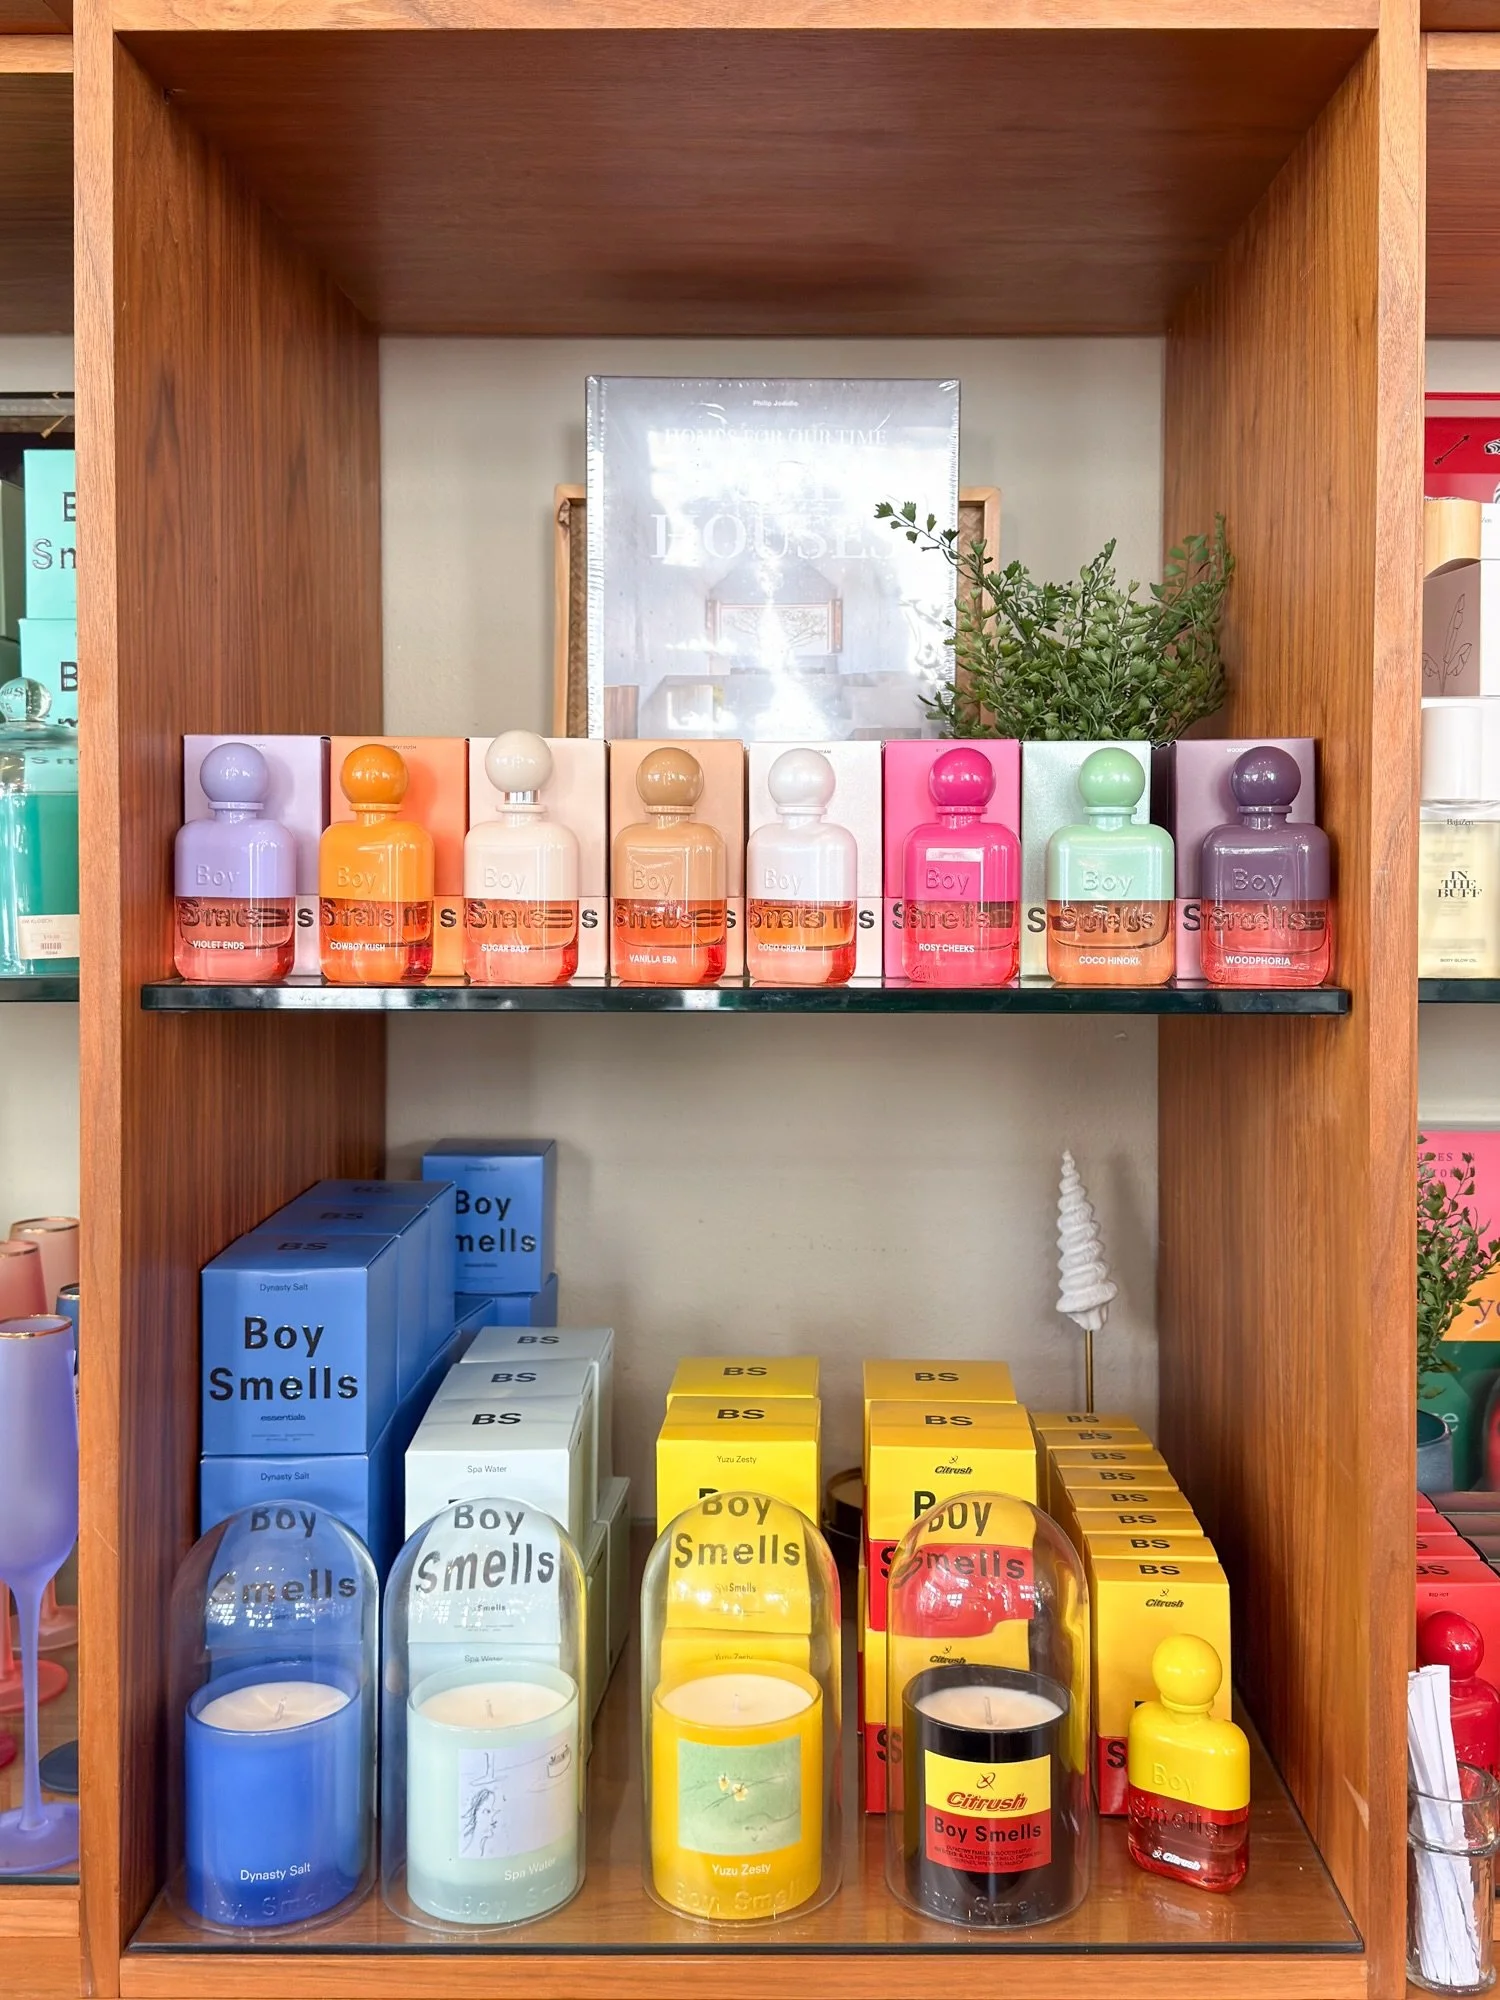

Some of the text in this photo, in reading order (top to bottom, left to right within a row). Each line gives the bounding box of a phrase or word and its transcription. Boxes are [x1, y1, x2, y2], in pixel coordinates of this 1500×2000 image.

[838, 428, 888, 446] TIME
[651, 513, 896, 560] HOUSES
[196, 864, 241, 891] Boy
[336, 867, 377, 893] Boy
[484, 867, 528, 895] Boy
[764, 867, 804, 895] Boy
[925, 866, 971, 895] Boy
[1451, 871, 1468, 880] IN
[632, 868, 675, 897] Boy
[1081, 869, 1136, 898] Boy
[1231, 868, 1284, 897] Boy
[1441, 880, 1476, 889] THE
[1437, 889, 1483, 898] BUFF
[192, 940, 245, 951] VIOLET ENDS
[330, 941, 386, 952] COWBOY KUSH
[480, 943, 531, 953] SUGAR BABY
[780, 944, 807, 953] CREAM
[918, 943, 975, 953] ROSY CHEEKS
[628, 954, 678, 965] VANILLA ERA
[1079, 956, 1140, 966] COCO HINOKI
[1225, 955, 1292, 966] WOODPHORIA
[455, 1189, 512, 1221] Boy
[455, 1227, 537, 1253] mells
[276, 1242, 330, 1251] BS
[259, 1283, 309, 1292] Dynasty Salt
[244, 1315, 325, 1358] Boy
[517, 1335, 561, 1345] BS
[722, 1366, 768, 1376] BS
[490, 1372, 538, 1383] BS
[914, 1372, 960, 1382] BS
[209, 1365, 359, 1401] Smells
[472, 1412, 523, 1425] BS
[717, 1409, 766, 1420] BS
[1066, 1415, 1100, 1424] BS
[924, 1415, 974, 1426] BS
[1078, 1432, 1113, 1440] BS
[717, 1455, 757, 1465] Yuzu Zesty
[1091, 1452, 1127, 1461] BS
[467, 1464, 508, 1473] Spa Water
[934, 1465, 974, 1475] Citrush
[260, 1472, 310, 1481] Dynasty Salt
[1100, 1472, 1136, 1481] BS
[1110, 1493, 1149, 1503] BS
[700, 1491, 772, 1526] Boy
[250, 1506, 317, 1539] Boy
[453, 1503, 526, 1536] Boy
[922, 1497, 993, 1537] Boy
[1118, 1515, 1158, 1525] BS
[1130, 1539, 1171, 1549] BS
[674, 1532, 801, 1569] Smells
[415, 1542, 555, 1594] Smells
[890, 1549, 1026, 1590] Smells
[1139, 1564, 1181, 1576] BS
[1145, 1598, 1185, 1609] Citrush
[1152, 1762, 1198, 1797] Boy
[946, 1790, 1029, 1812] Citrush
[934, 1815, 1042, 1843] Boy Smells
[240, 1862, 311, 1884] Dynasty Salt
[504, 1857, 558, 1882] Spa Water
[711, 1863, 772, 1877] Yuzu Zesty
